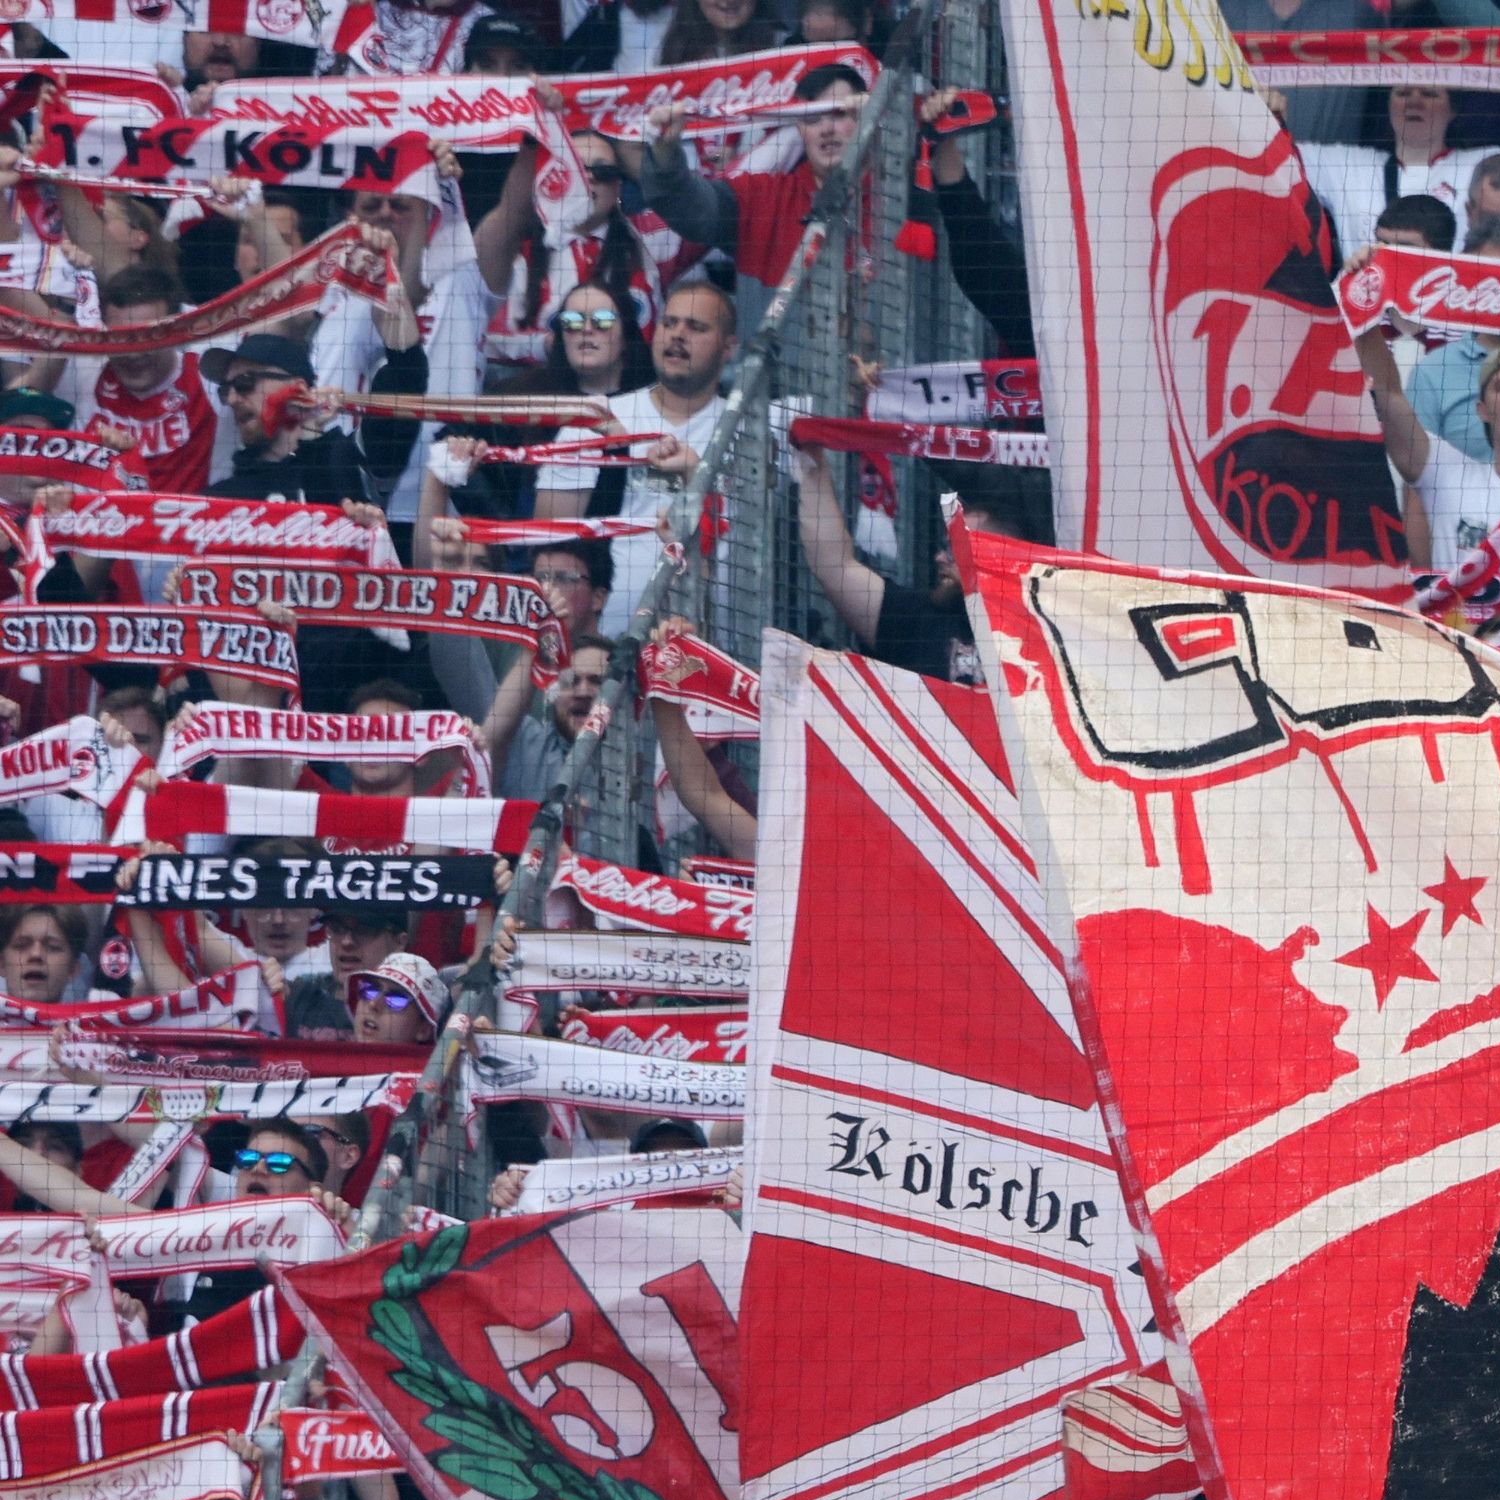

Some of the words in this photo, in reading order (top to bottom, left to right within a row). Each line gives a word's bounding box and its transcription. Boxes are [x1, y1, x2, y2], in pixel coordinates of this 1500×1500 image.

[47, 122, 101, 167] 1.
[122, 126, 196, 168] FC
[225, 128, 397, 183] KÖLN
[913, 378, 950, 404] 1.
[964, 370, 1027, 399] FC
[1192, 300, 1252, 440] 1.
[1212, 448, 1410, 565] KÖLN
[229, 569, 345, 609] SIND
[356, 574, 436, 614] DIE
[2, 615, 97, 652] SIND
[106, 616, 184, 656] DER
[2, 739, 70, 779] KÖLN
[565, 1077, 694, 1106] BORUSSIA
[825, 1111, 1100, 1249] Kölsche
[222, 1214, 299, 1251] Köln
